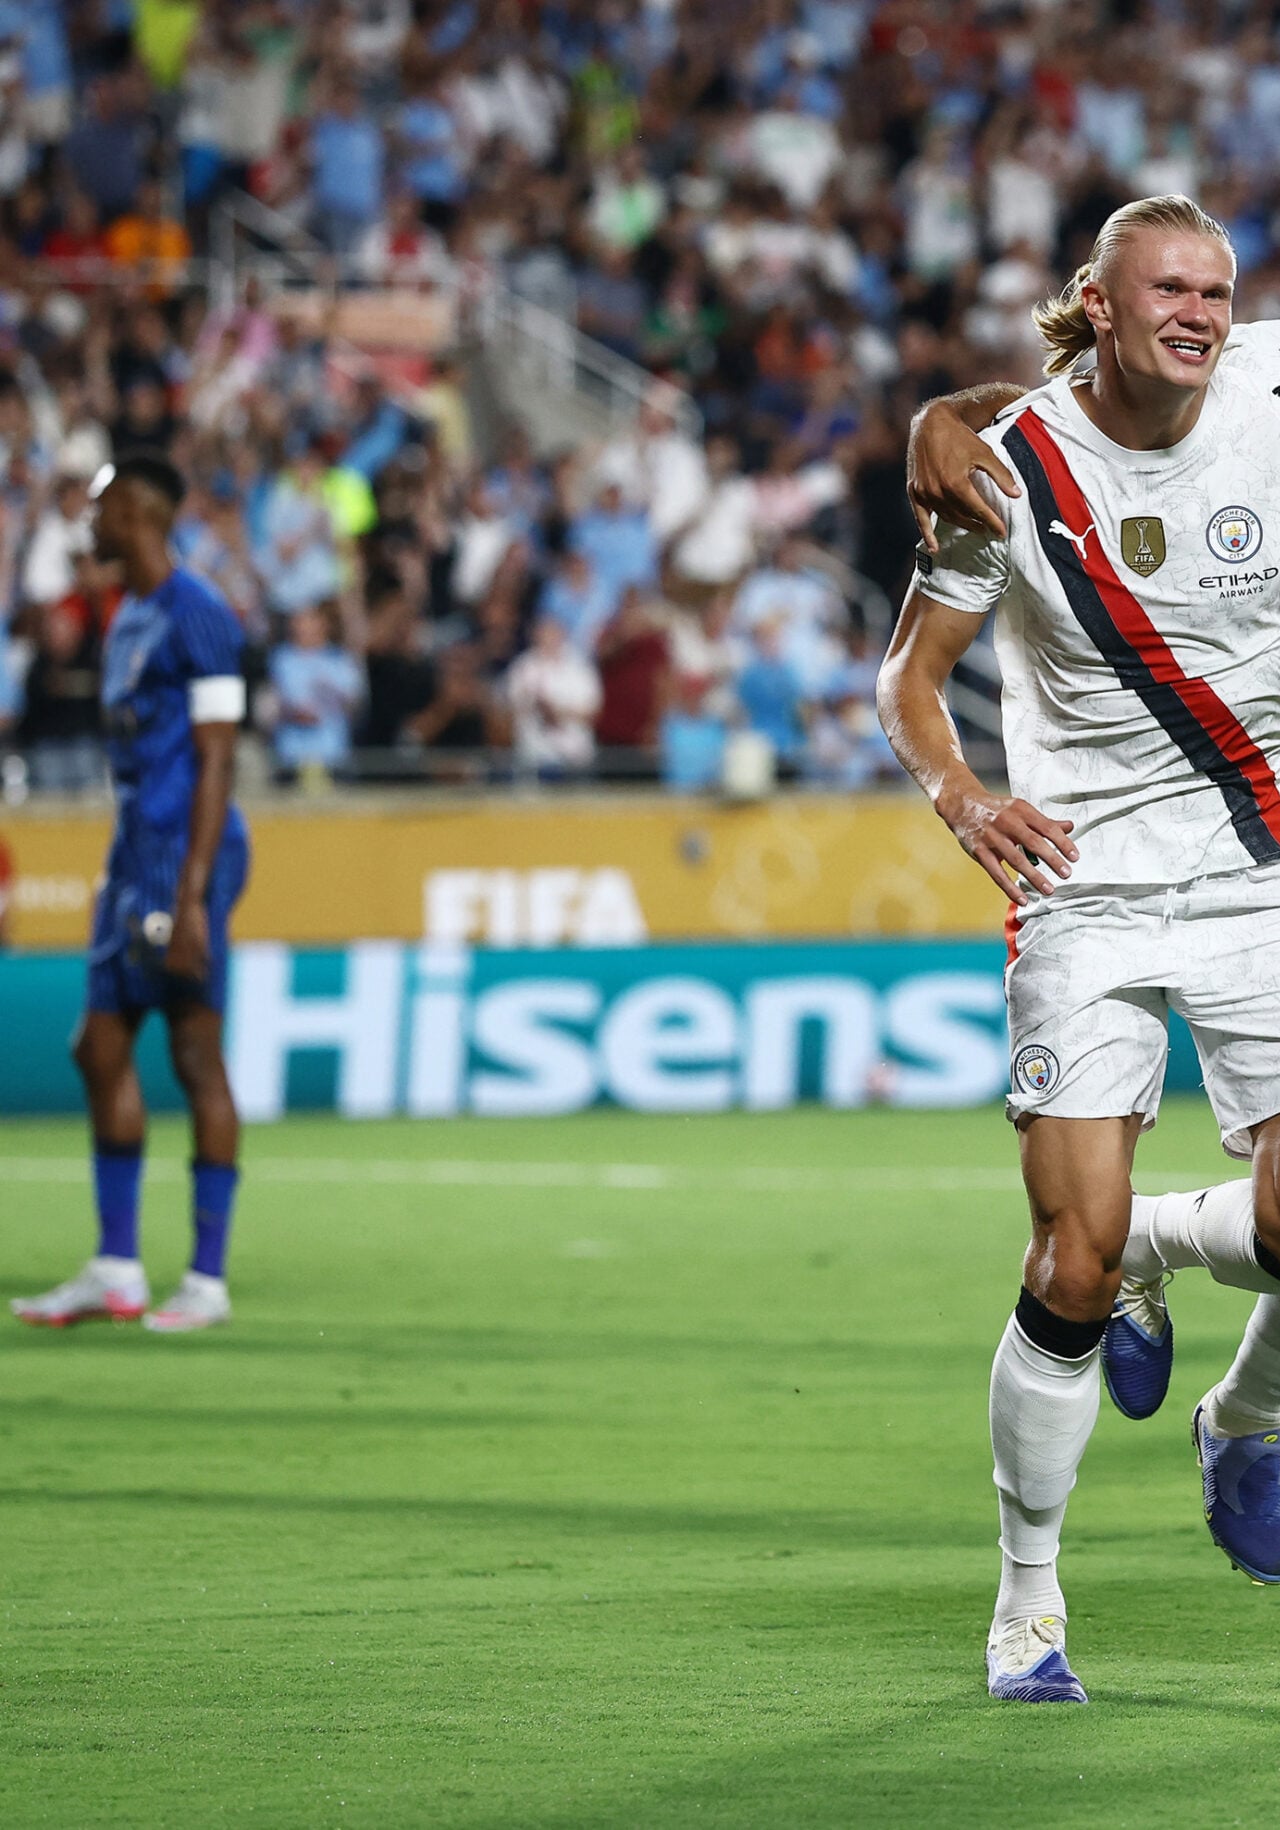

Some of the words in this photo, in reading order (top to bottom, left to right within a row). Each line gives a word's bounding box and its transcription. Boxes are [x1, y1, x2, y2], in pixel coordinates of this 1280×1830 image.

[1212, 510, 1256, 529] MANCHESTER
[1134, 554, 1156, 563] FIFA
[1199, 567, 1279, 589] ETIHAD
[1219, 584, 1264, 599] AIRWAYS
[424, 867, 648, 946] FIFA
[232, 941, 1008, 1118] Hisens
[1018, 1049, 1052, 1072] MANCHESTER
